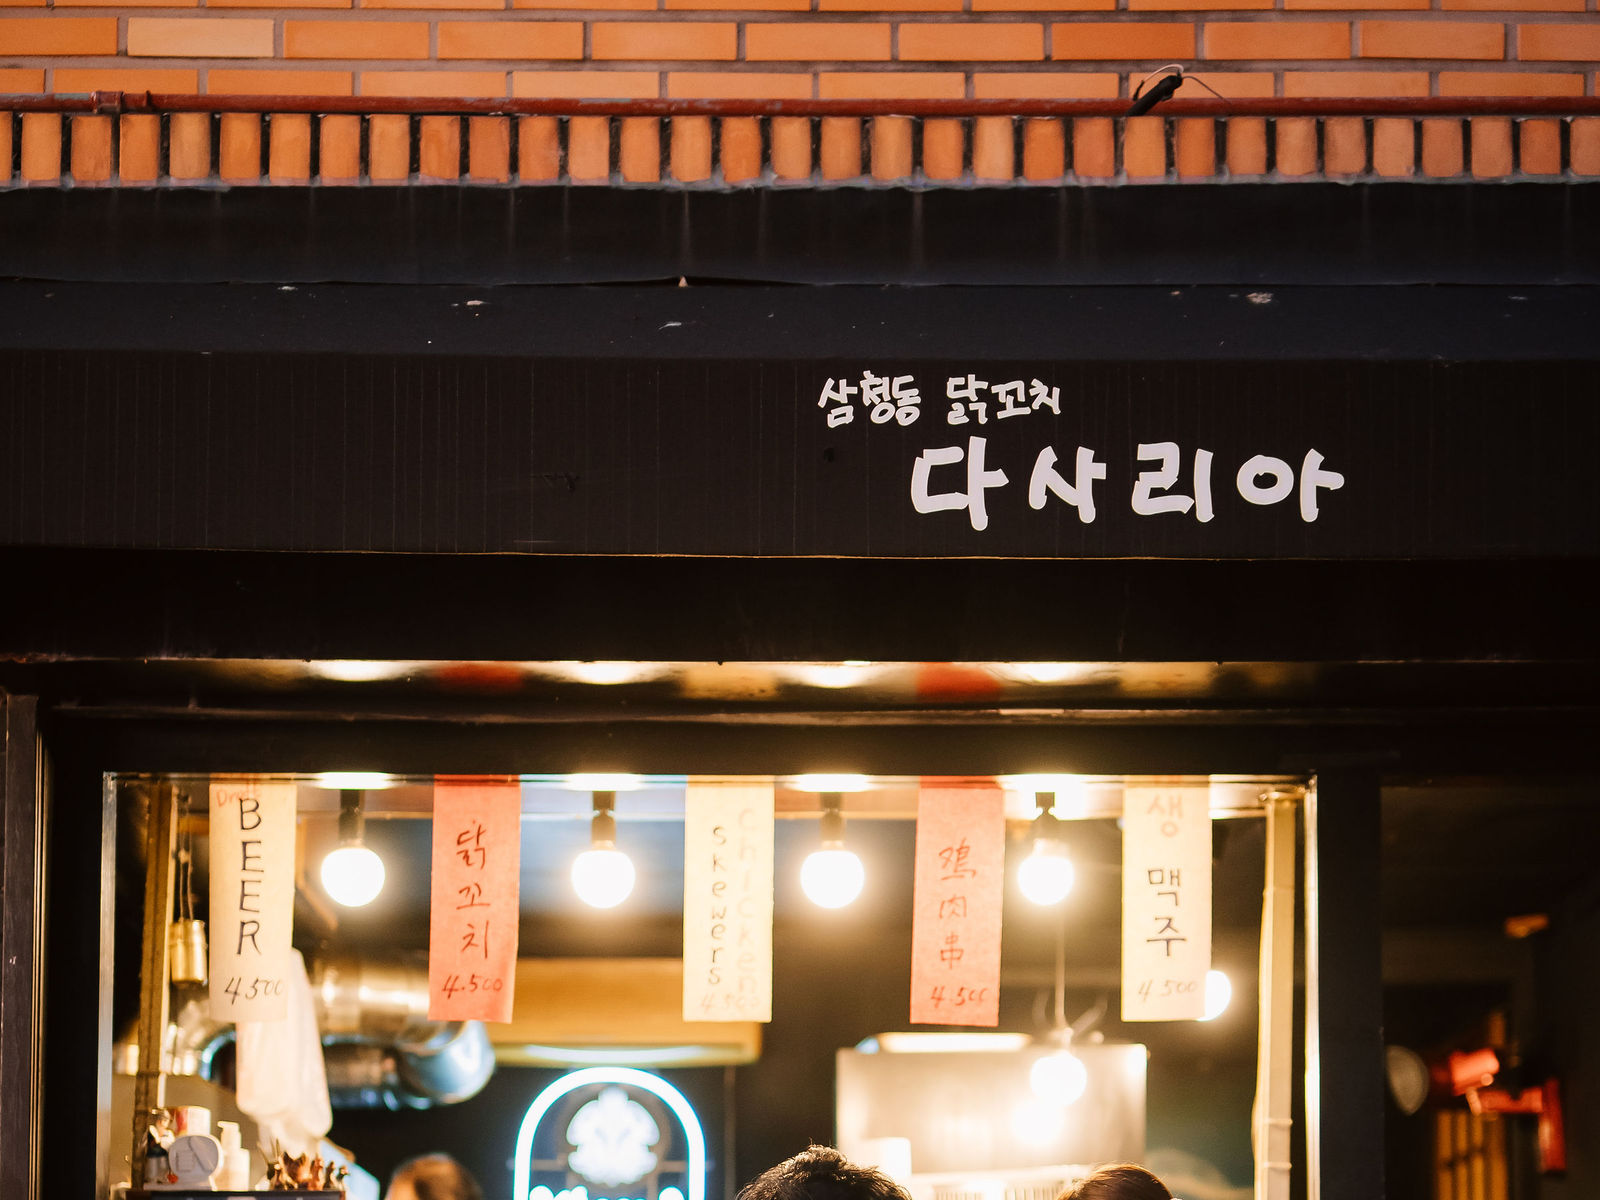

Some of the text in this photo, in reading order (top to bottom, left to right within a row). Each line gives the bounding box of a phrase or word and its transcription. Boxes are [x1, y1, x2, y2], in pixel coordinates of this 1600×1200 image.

[946, 373, 1061, 425] 닭꼬치
[910, 435, 1345, 531] 다사리아
[236, 796, 265, 956] BEER
[455, 818, 491, 959] 닭꼬치
